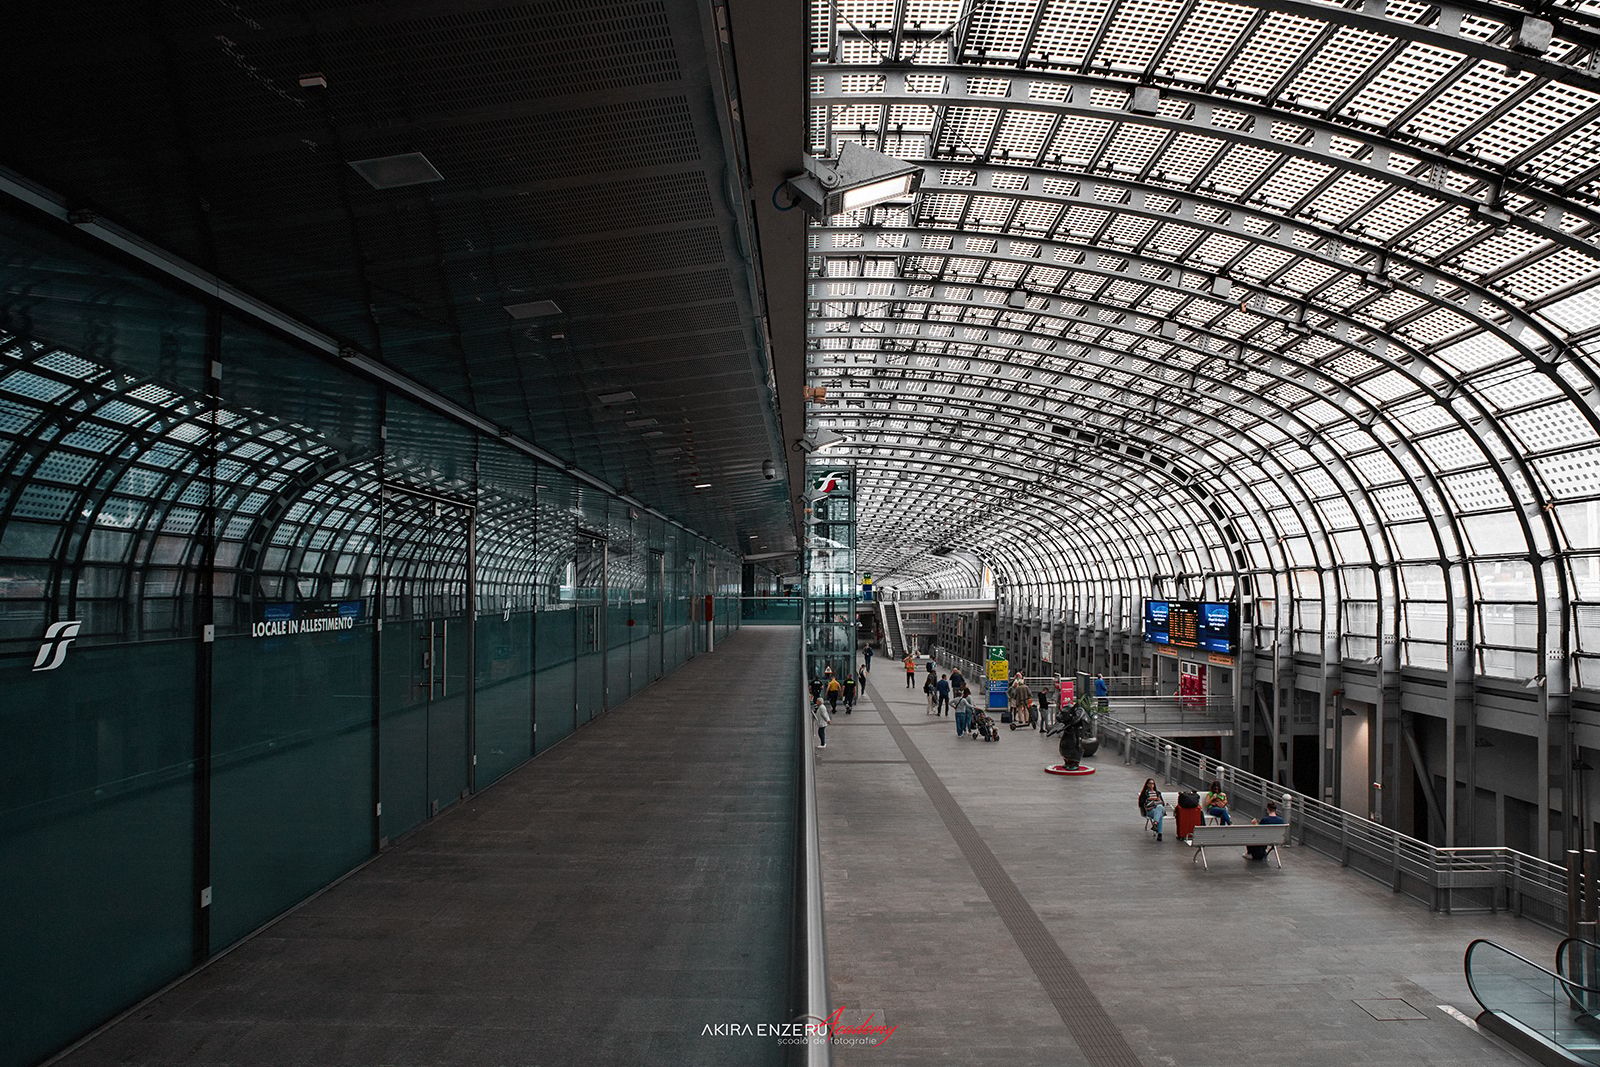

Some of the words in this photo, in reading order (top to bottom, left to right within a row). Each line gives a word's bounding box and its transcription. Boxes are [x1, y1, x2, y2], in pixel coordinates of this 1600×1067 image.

[252, 621, 286, 637] LOCALE
[288, 620, 299, 634] IN
[300, 616, 353, 632] ALLESTIMENTO
